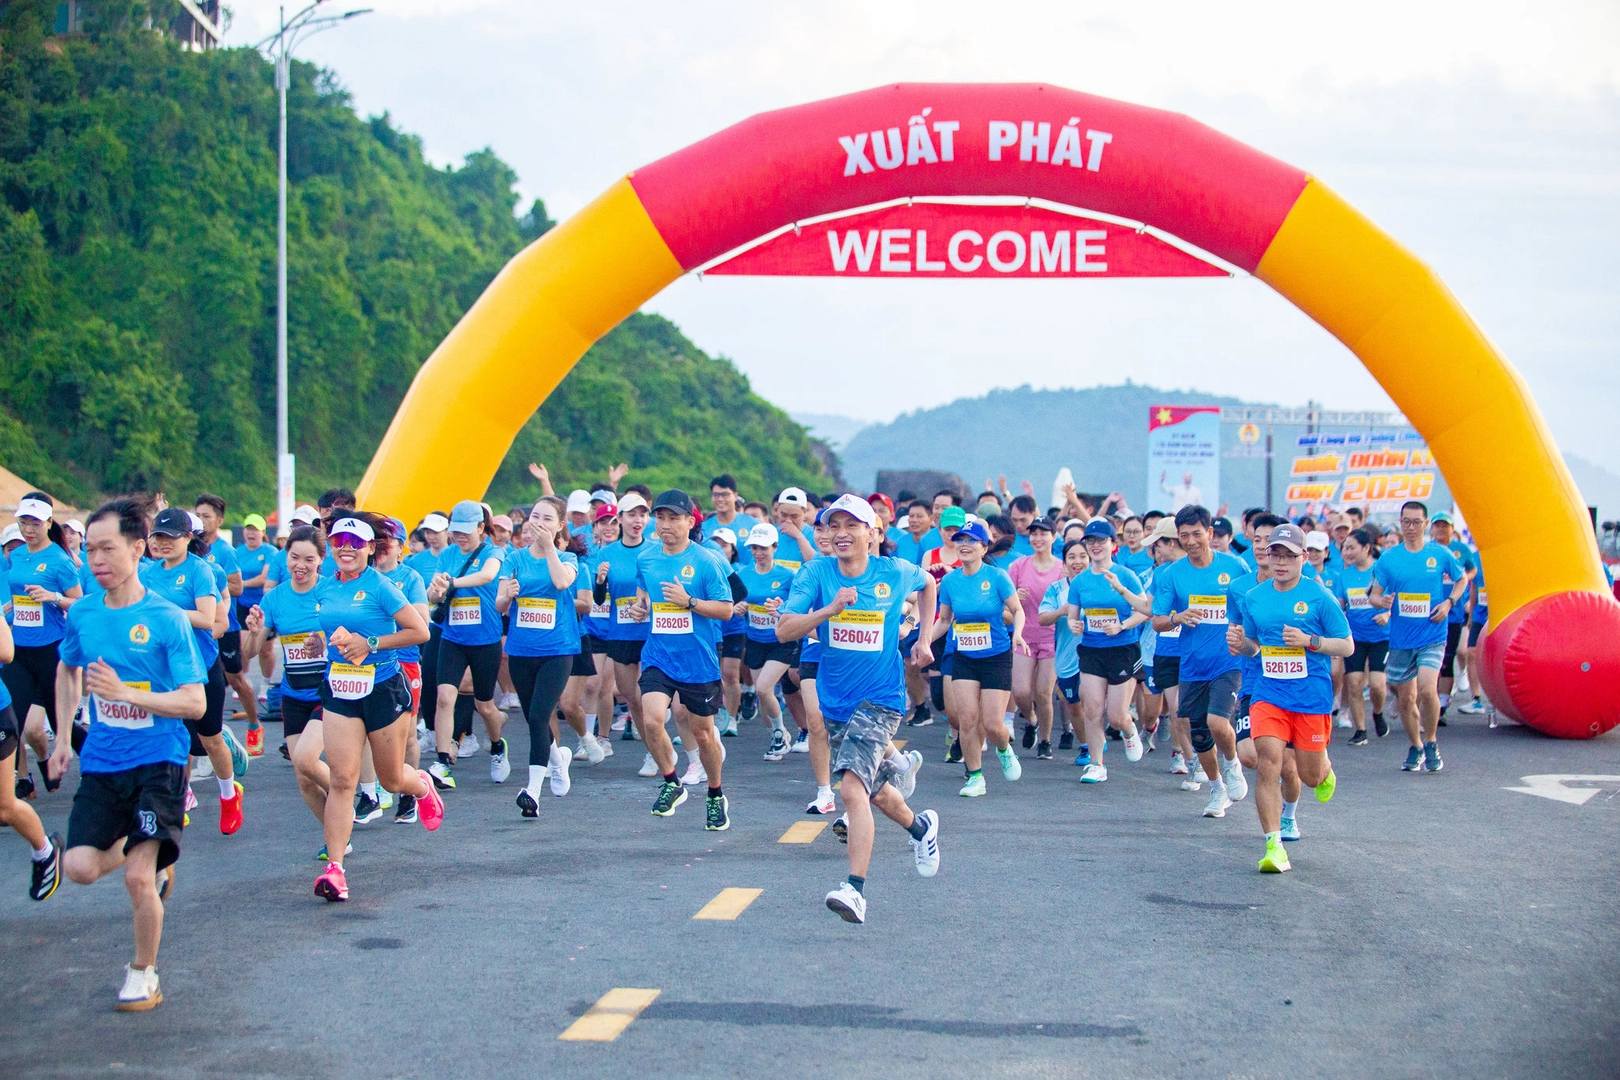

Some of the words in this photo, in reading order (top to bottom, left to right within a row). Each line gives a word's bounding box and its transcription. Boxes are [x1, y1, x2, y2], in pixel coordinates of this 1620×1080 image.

[838, 107, 960, 176] XUẤT
[988, 117, 1113, 172] PHÁT
[826, 229, 1109, 273] WELCOME
[1342, 473, 1433, 501] 2026
[452, 609, 480, 621] 526162
[520, 611, 553, 624] 526060
[655, 617, 690, 629] 526205
[833, 628, 879, 644] 526047
[959, 635, 988, 647] 526161
[1265, 661, 1304, 673] 526125
[331, 680, 368, 693] 526001
[138, 810, 158, 836] B
